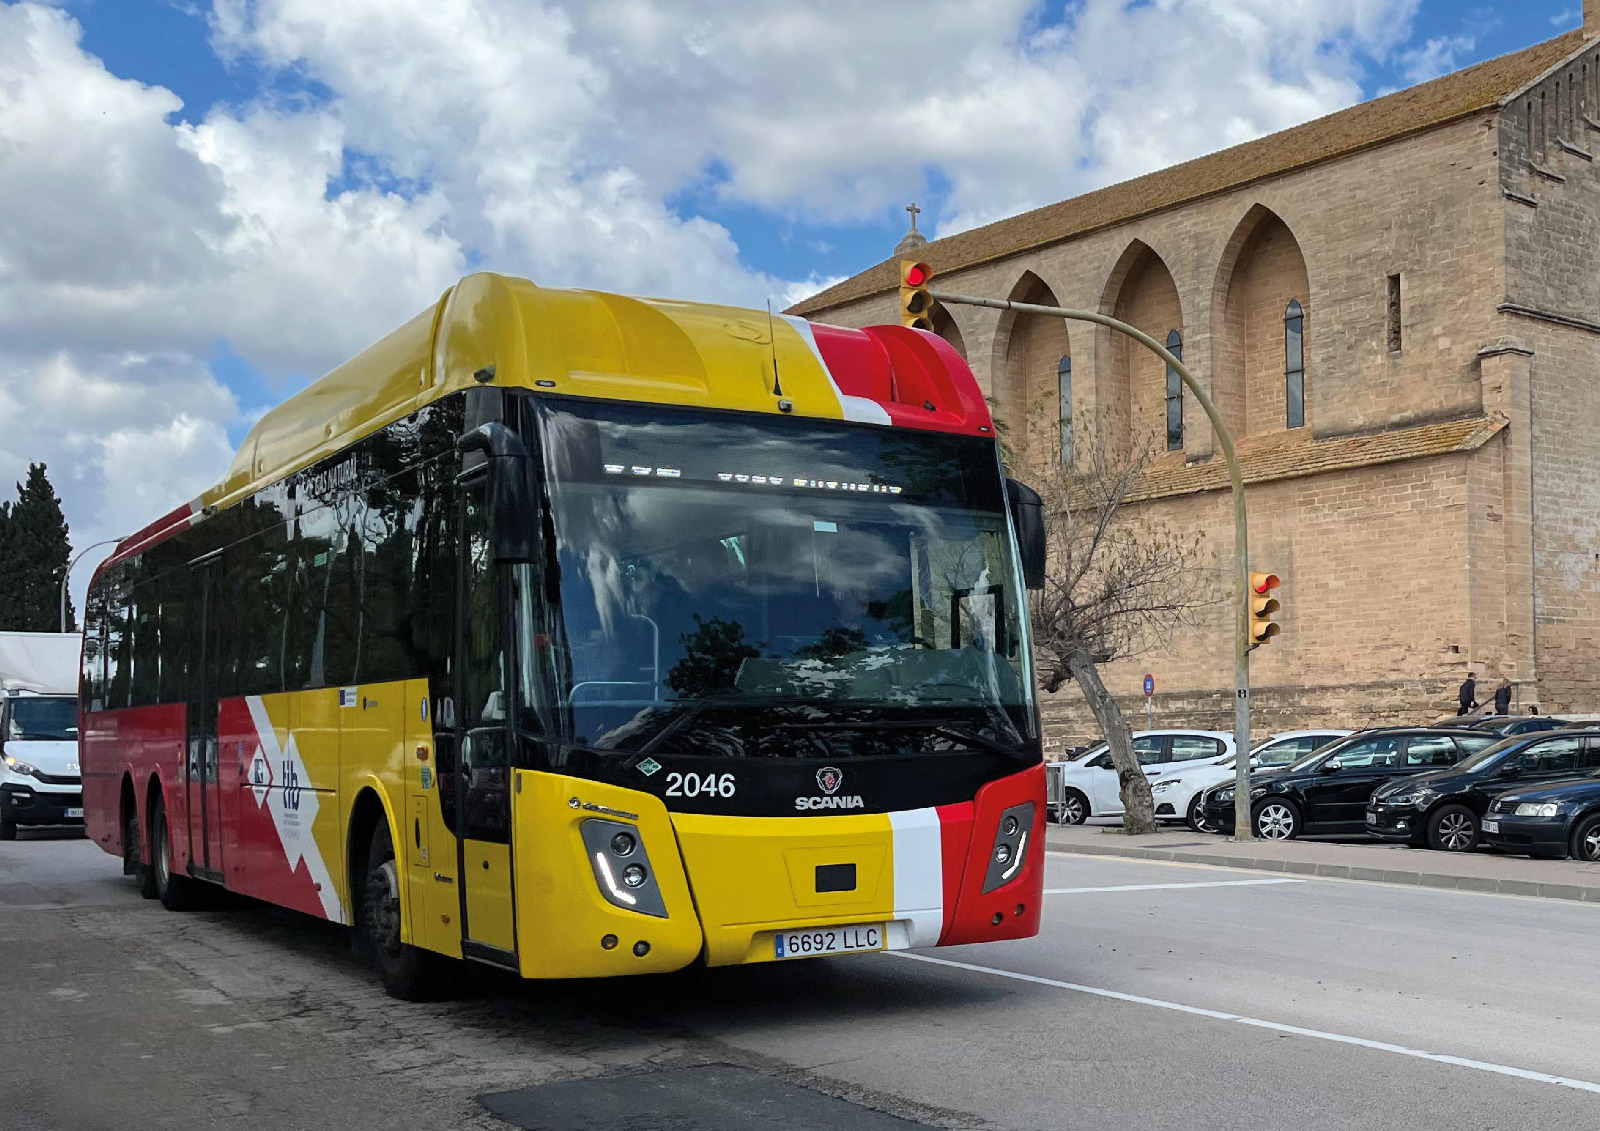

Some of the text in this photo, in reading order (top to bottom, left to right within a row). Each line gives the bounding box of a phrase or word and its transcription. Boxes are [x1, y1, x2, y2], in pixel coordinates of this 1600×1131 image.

[665, 772, 736, 798] 2046
[794, 795, 865, 811] SCANIA
[788, 928, 878, 953] 6692 LLC
